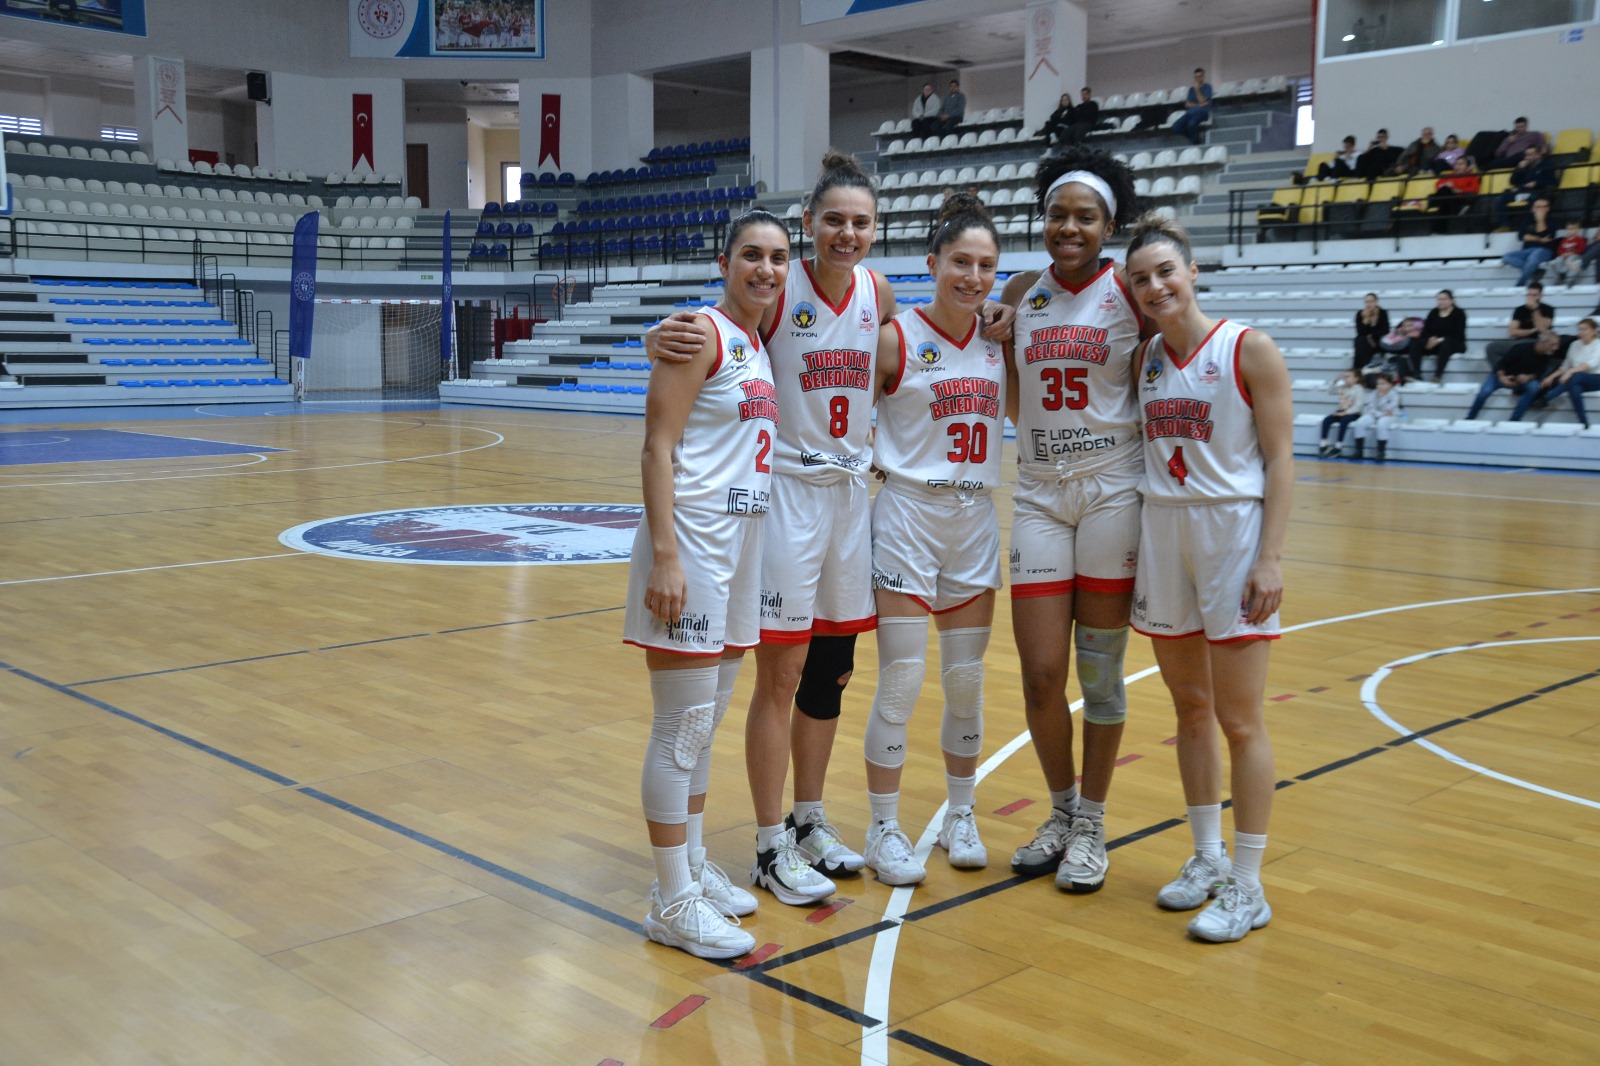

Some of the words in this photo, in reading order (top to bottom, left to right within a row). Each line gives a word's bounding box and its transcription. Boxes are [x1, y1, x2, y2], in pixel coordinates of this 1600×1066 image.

[1030, 325, 1108, 347] TURGUTLU
[802, 349, 871, 371] TURGUTLU
[1024, 342, 1111, 366] BELEDİYESİ
[799, 368, 871, 392] BELEDİYESİ
[930, 377, 999, 400] TURGUTLU
[1040, 368, 1088, 411] 35
[830, 396, 849, 438] 8
[929, 396, 999, 421] BELEDİYESİ
[755, 429, 771, 474] 2
[947, 422, 988, 464] 30
[1051, 436, 1116, 454] GARDEN
[1168, 446, 1188, 486] 4
[1148, 621, 1173, 629] TRYON
